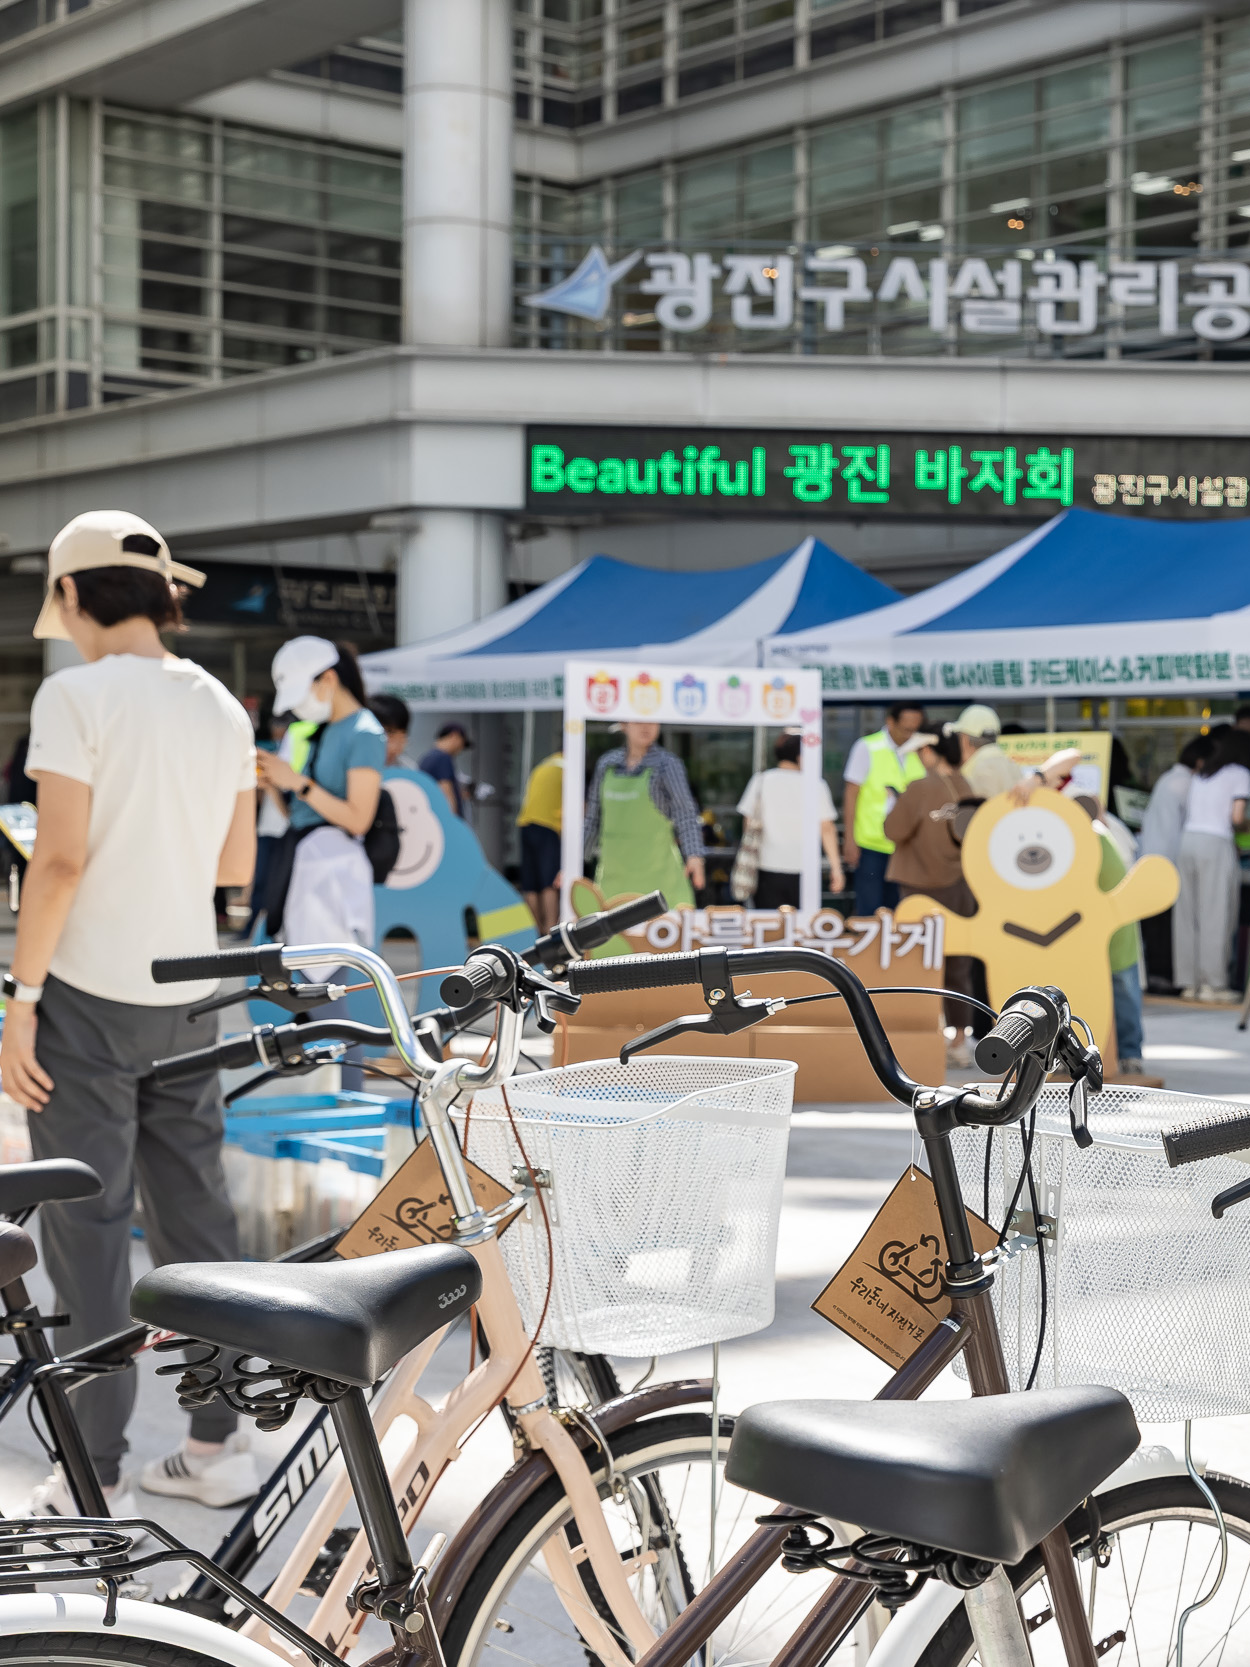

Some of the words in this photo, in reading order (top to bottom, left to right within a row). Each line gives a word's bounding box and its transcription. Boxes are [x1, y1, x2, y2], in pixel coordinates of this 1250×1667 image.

[531, 445, 766, 497] Beautiful
[784, 443, 890, 504] 광진
[914, 446, 1075, 505] 바자회
[850, 1277, 889, 1314] 우리동네
[887, 1307, 926, 1343] 자전거포
